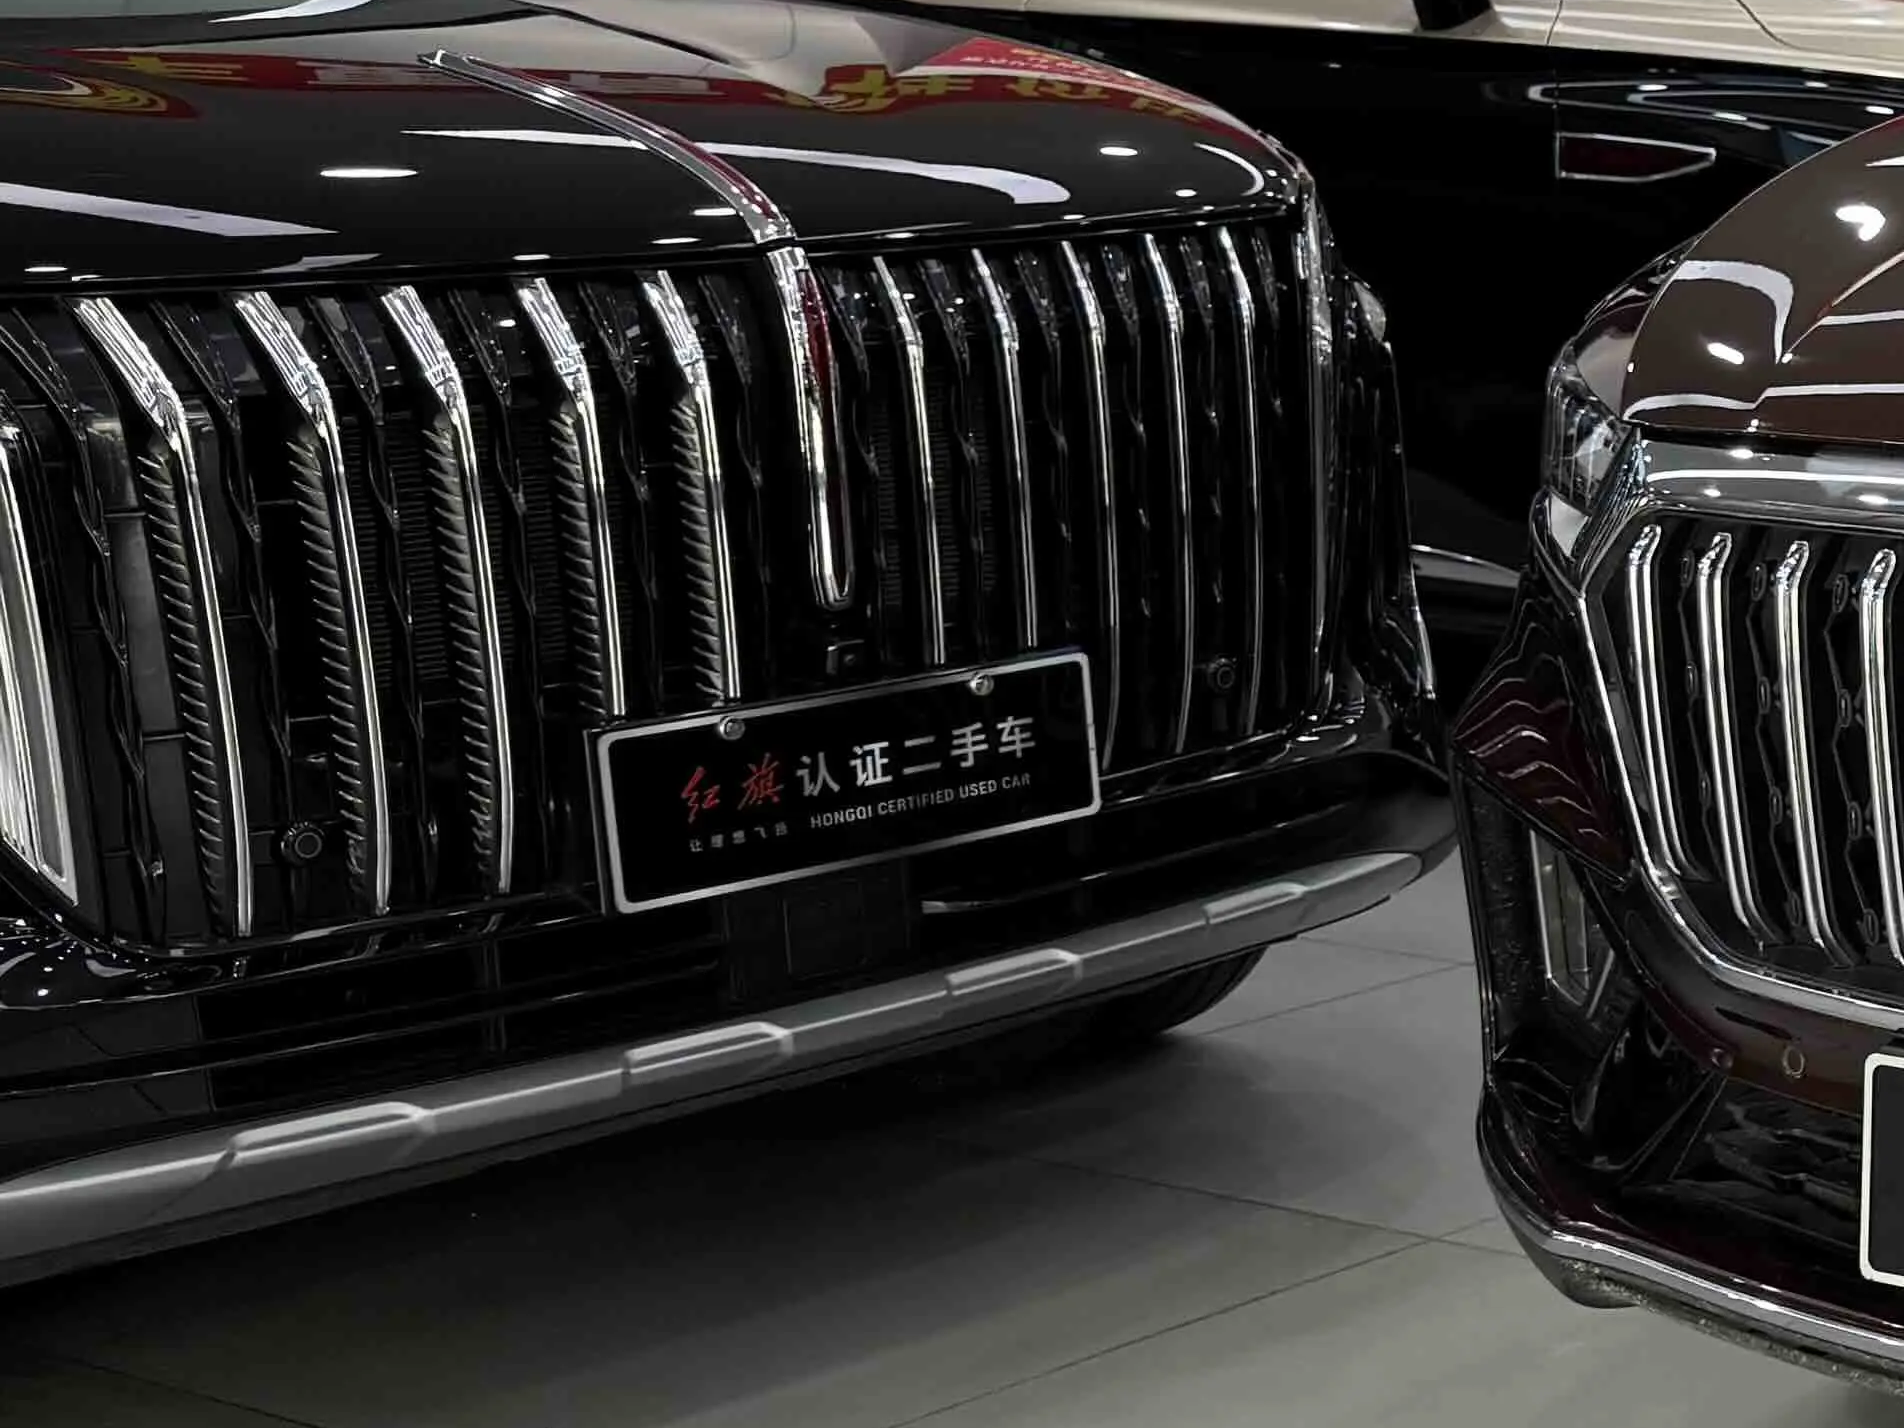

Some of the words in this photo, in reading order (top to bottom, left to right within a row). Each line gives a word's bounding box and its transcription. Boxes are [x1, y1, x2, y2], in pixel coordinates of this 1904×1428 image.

[810, 804, 873, 829] HONGQI
[877, 787, 955, 816] CERTIFIED
[959, 778, 998, 799] USED
[1001, 772, 1032, 789] CAR
